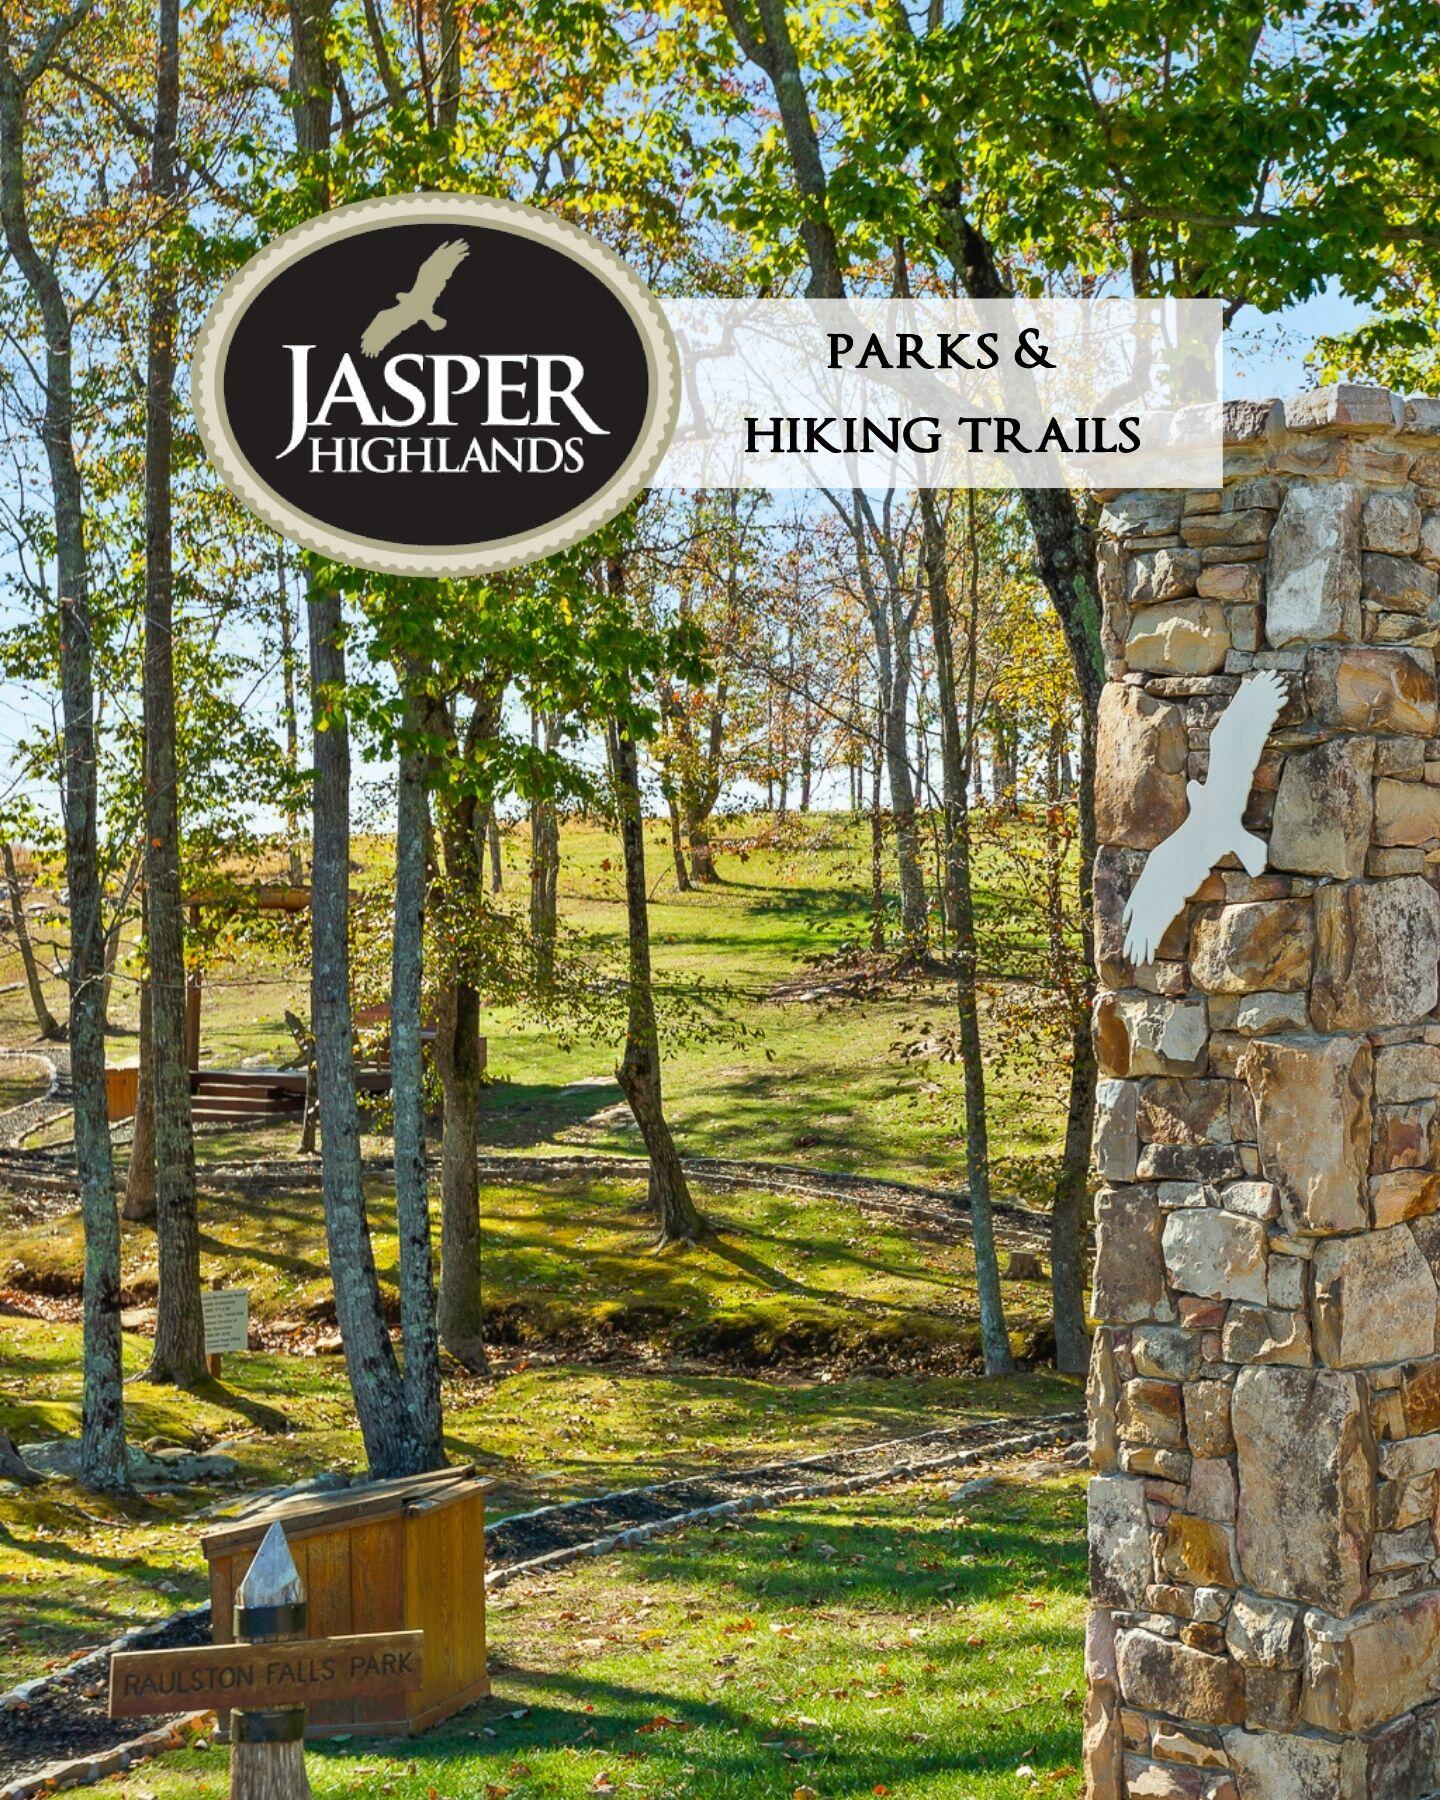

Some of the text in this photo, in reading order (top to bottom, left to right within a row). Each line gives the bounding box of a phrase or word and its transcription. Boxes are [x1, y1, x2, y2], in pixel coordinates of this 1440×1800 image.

[123, 1650, 414, 1697] RAULSTON FALLS PARK
